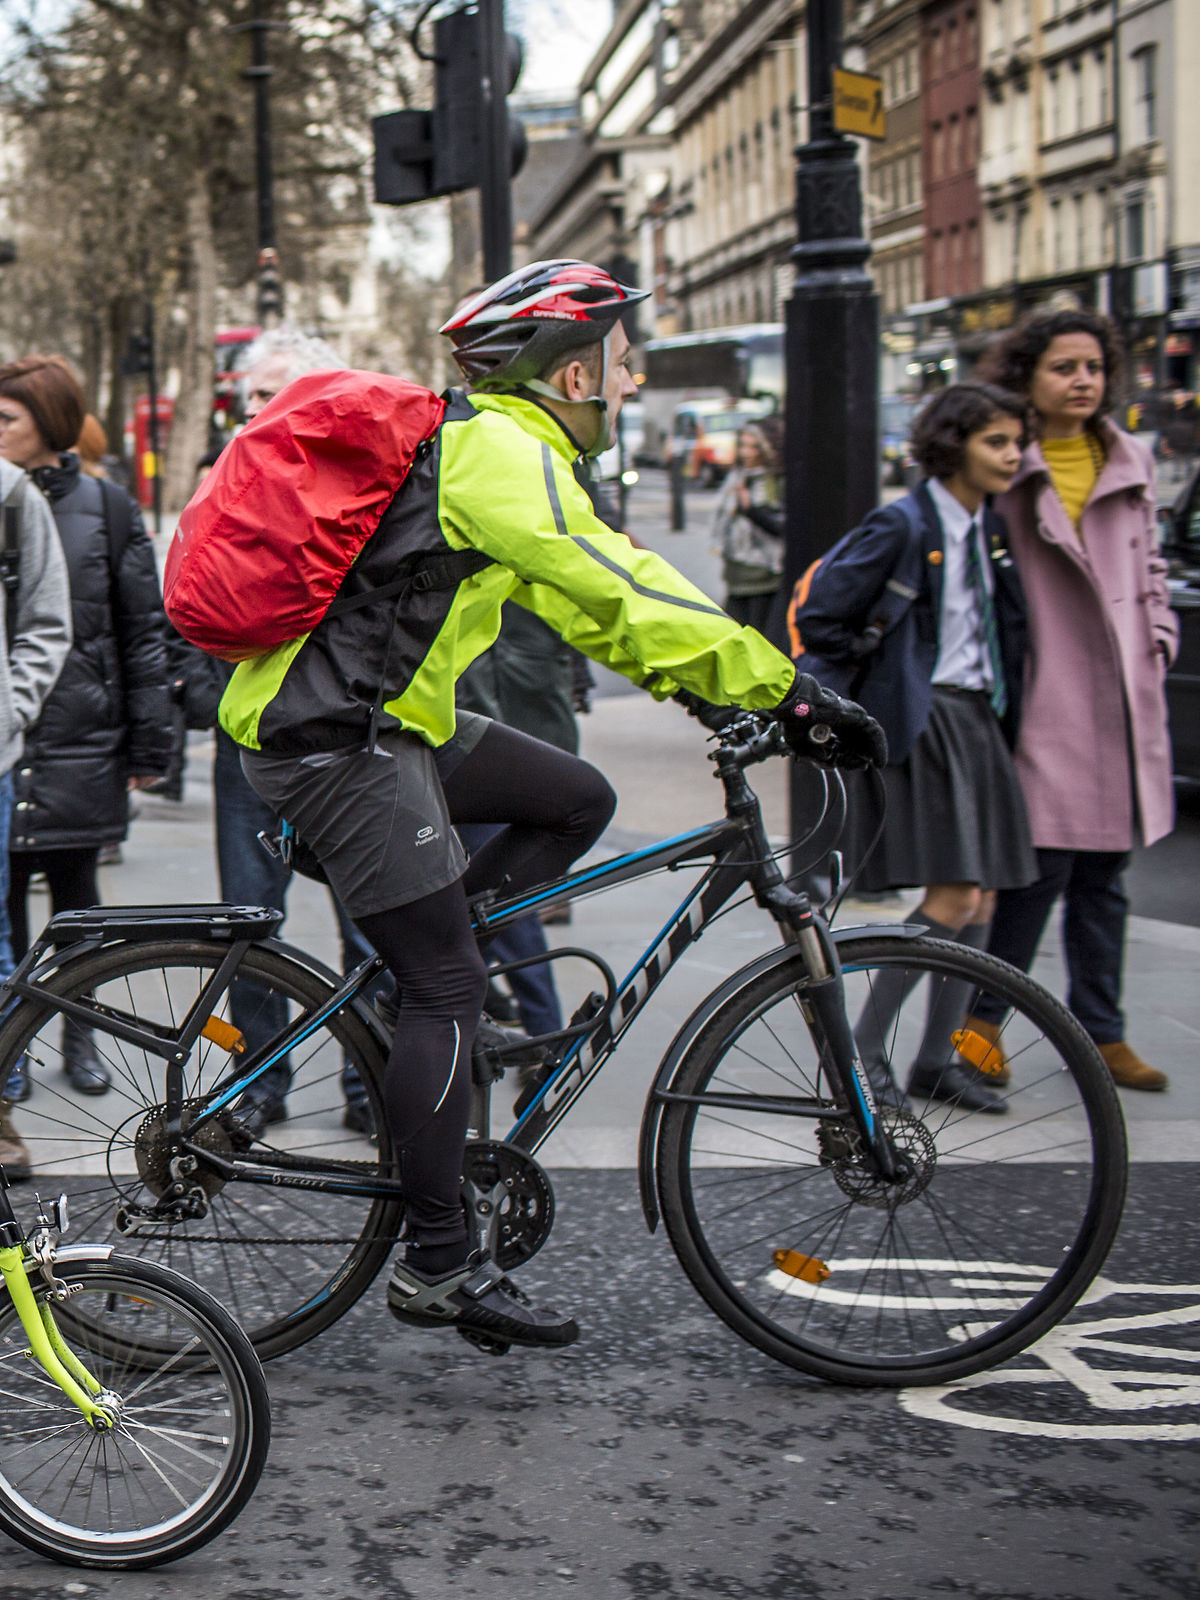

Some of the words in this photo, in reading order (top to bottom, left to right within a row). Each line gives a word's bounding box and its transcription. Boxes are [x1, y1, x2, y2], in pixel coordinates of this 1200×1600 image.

[543, 879, 711, 1113] SCOTT
[858, 1073, 878, 1114] SUNTOUR
[281, 1175, 328, 1188] SCOTT
